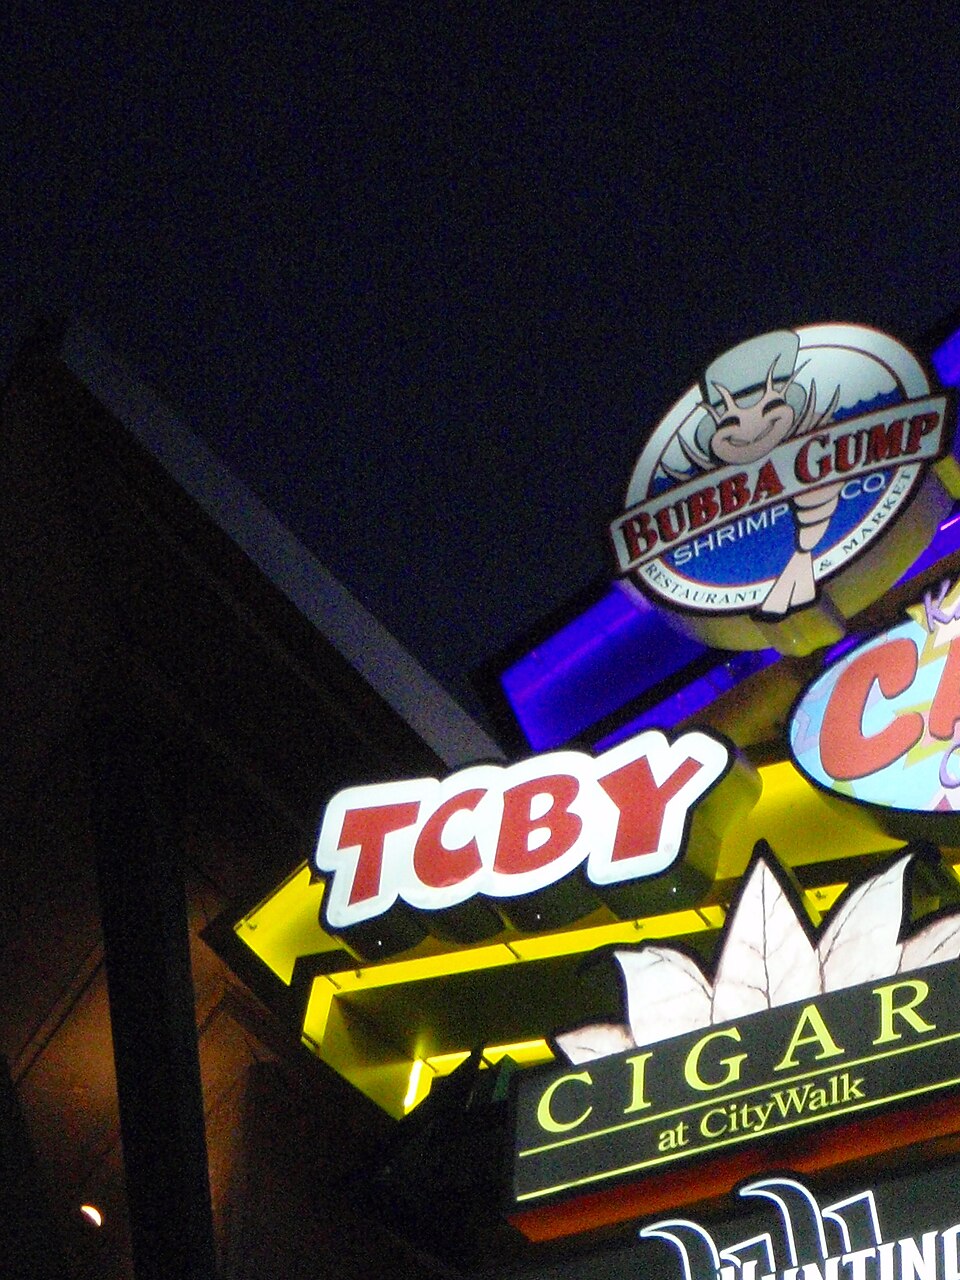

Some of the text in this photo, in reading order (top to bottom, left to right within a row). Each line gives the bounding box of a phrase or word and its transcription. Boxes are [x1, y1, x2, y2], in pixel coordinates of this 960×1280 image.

[620, 410, 940, 562] BUBBA GUMP
[644, 470, 912, 604] RESTAURANT & MARKET
[673, 503, 790, 566] SHRIMP
[337, 754, 705, 907] TCBY
[657, 1073, 865, 1152] at CityWalk
